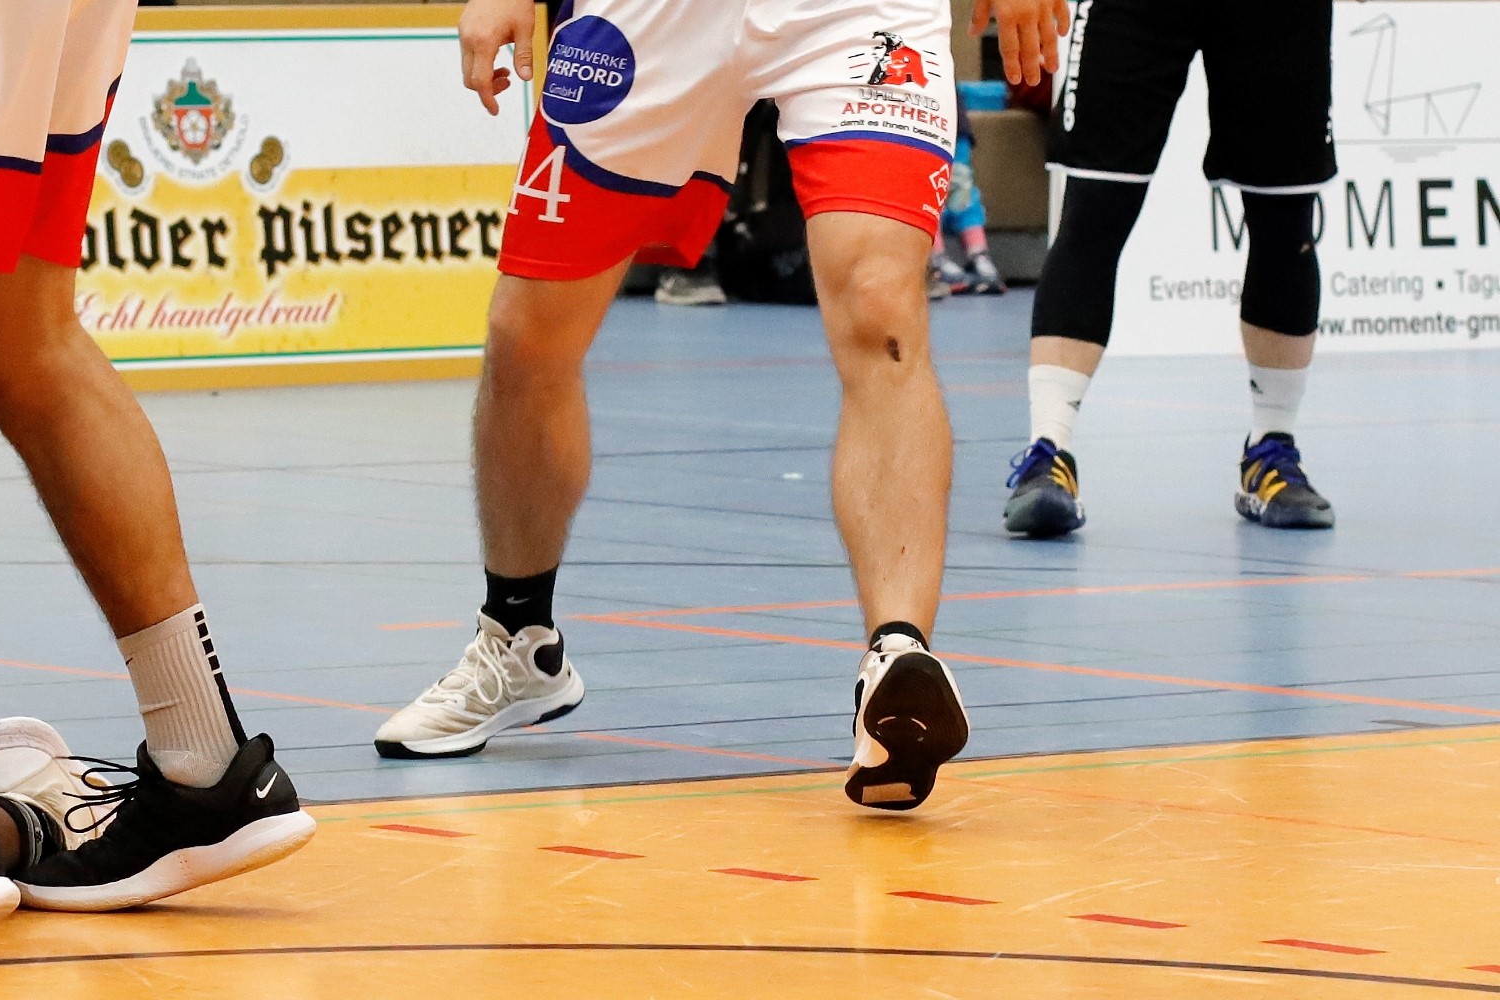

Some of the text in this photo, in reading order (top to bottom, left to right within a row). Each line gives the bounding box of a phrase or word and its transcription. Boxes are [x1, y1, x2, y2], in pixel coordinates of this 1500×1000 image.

[555, 42, 628, 70] STADTWERKE
[547, 57, 623, 88] HERFORD
[859, 88, 940, 113] UHLAND
[842, 102, 949, 132] APOTHEKE
[1211, 179, 1500, 251] MMEN
[258, 201, 500, 278] Pilsener
[1331, 269, 1424, 301] Catering
[148, 290, 338, 339] handgebraut
